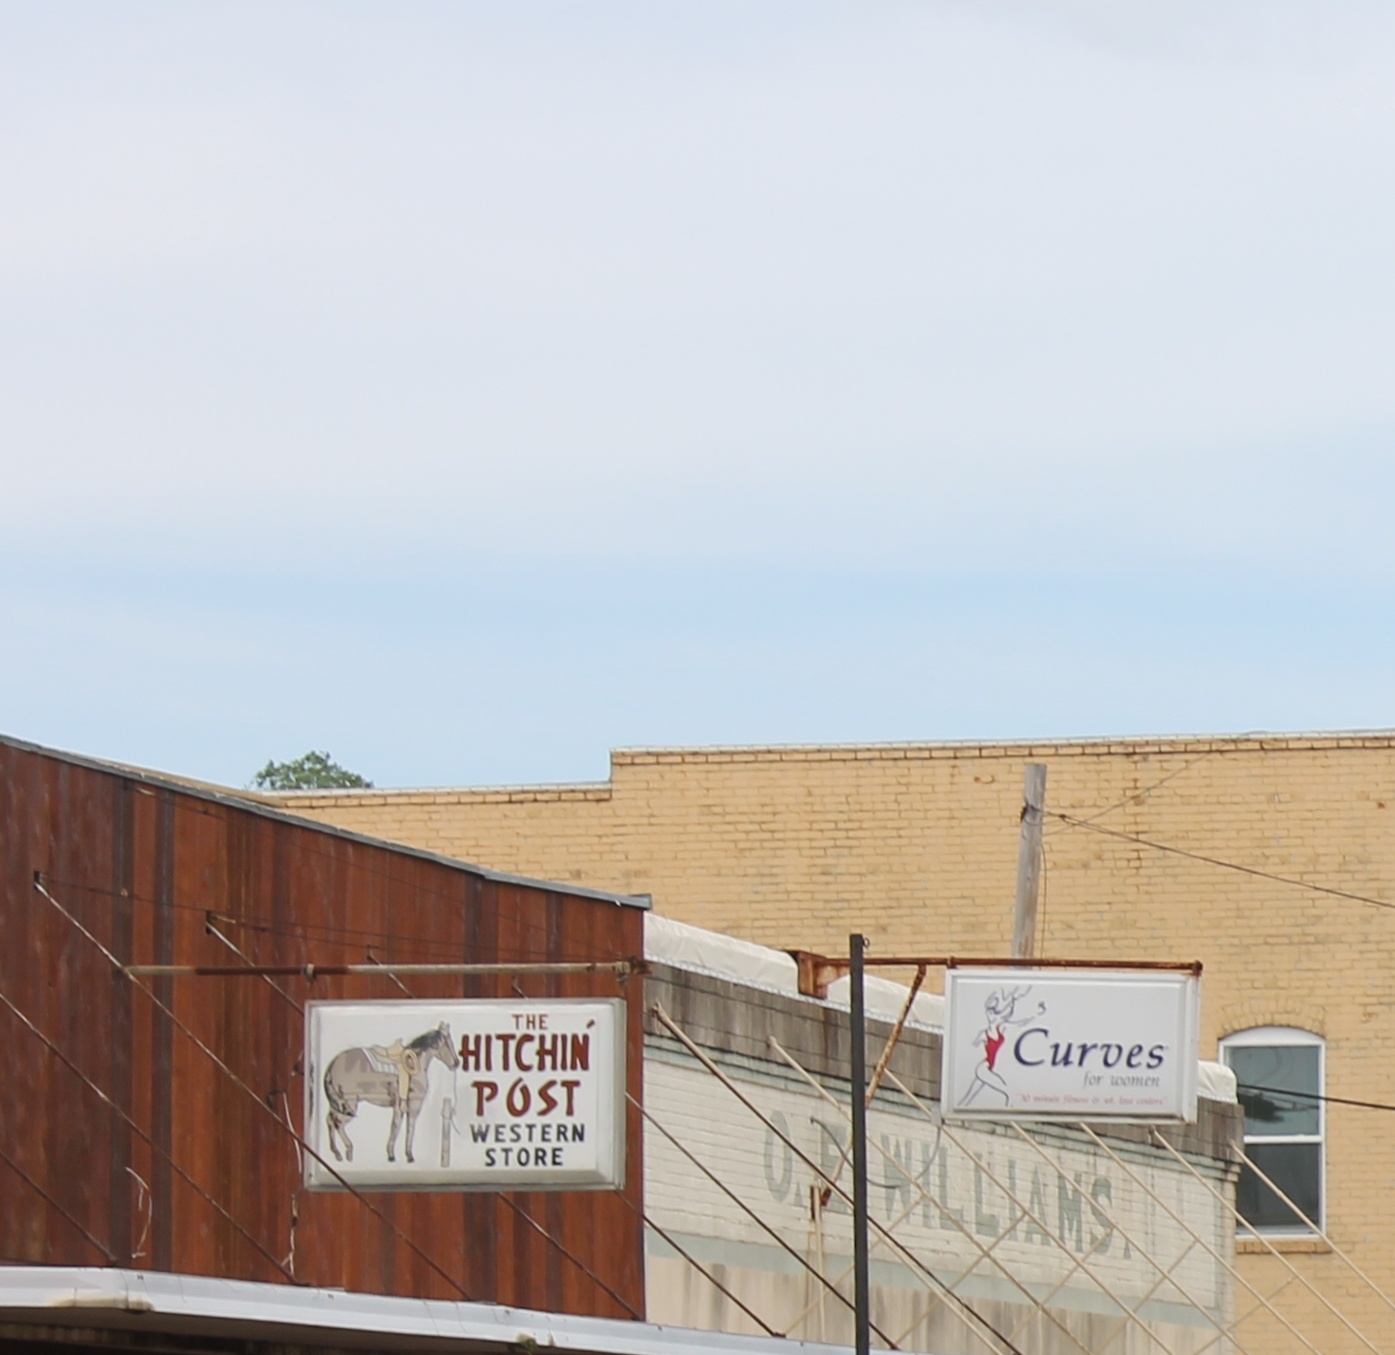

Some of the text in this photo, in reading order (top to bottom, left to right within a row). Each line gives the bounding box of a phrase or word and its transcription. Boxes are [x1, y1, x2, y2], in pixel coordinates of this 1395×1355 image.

[513, 1014, 549, 1030] THE
[1013, 1028, 1165, 1070] Curves
[1082, 1070, 1160, 1089] for women
[471, 1077, 582, 1117] POST
[470, 1123, 585, 1143] WESTERN
[484, 1146, 564, 1167] STORE
